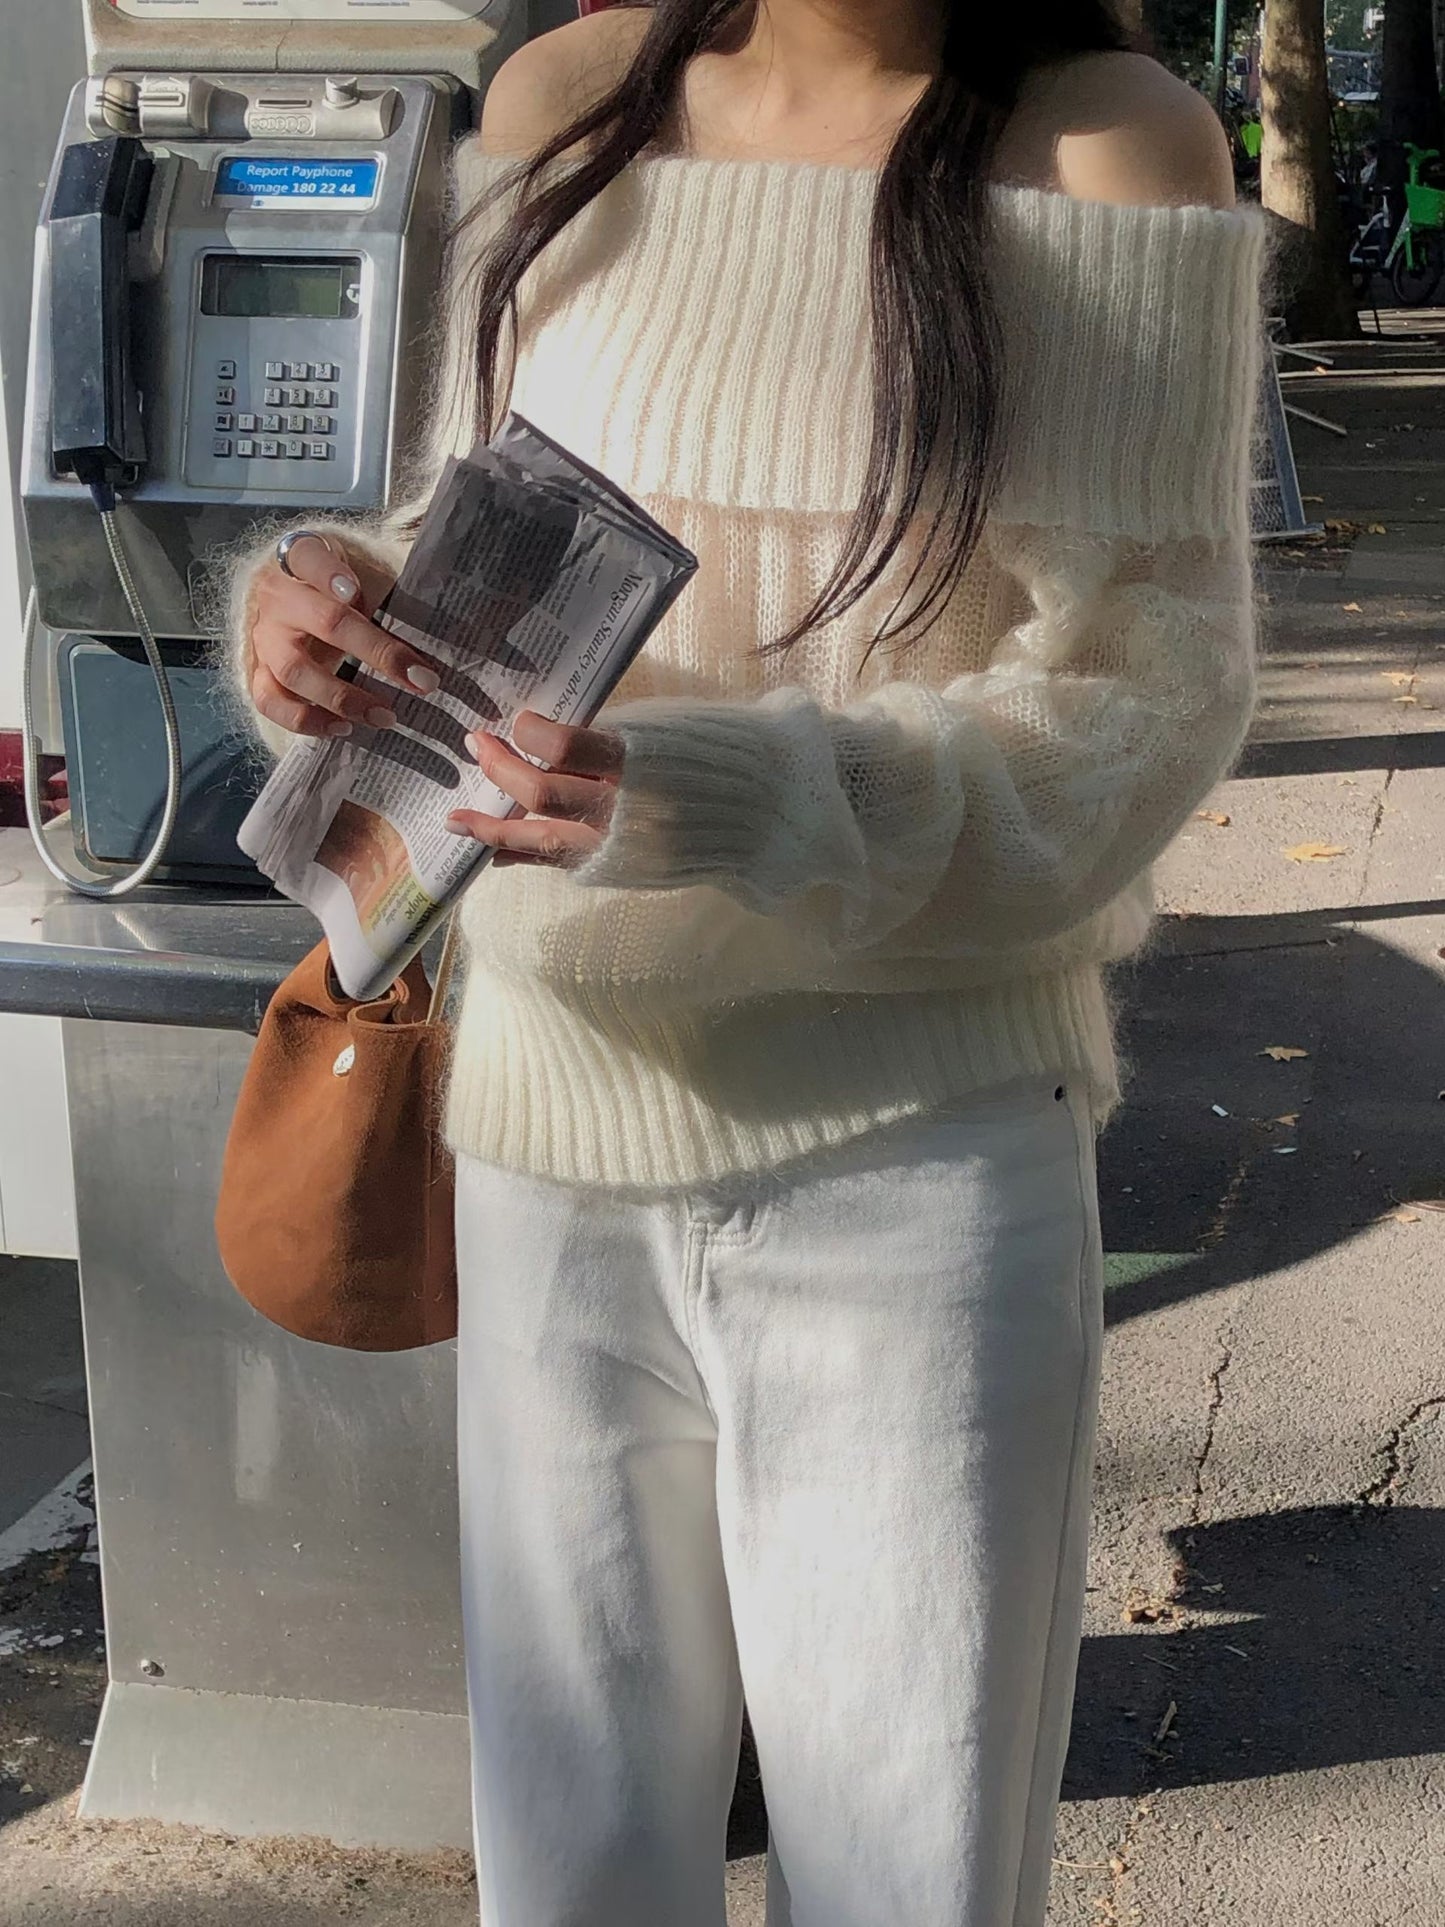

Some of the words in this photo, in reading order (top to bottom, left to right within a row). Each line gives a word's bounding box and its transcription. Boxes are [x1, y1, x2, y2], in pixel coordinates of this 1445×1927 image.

[247, 165, 288, 178] Report
[291, 165, 353, 179] Payphone
[237, 182, 289, 196] Damage
[291, 182, 317, 194] 180
[319, 183, 335, 194] 22
[338, 183, 356, 194] 44
[607, 569, 644, 623] Morgan
[577, 620, 612, 673] Stanley
[548, 670, 581, 723] advisers
[450, 849, 471, 877] divided
[404, 891, 427, 919] hope
